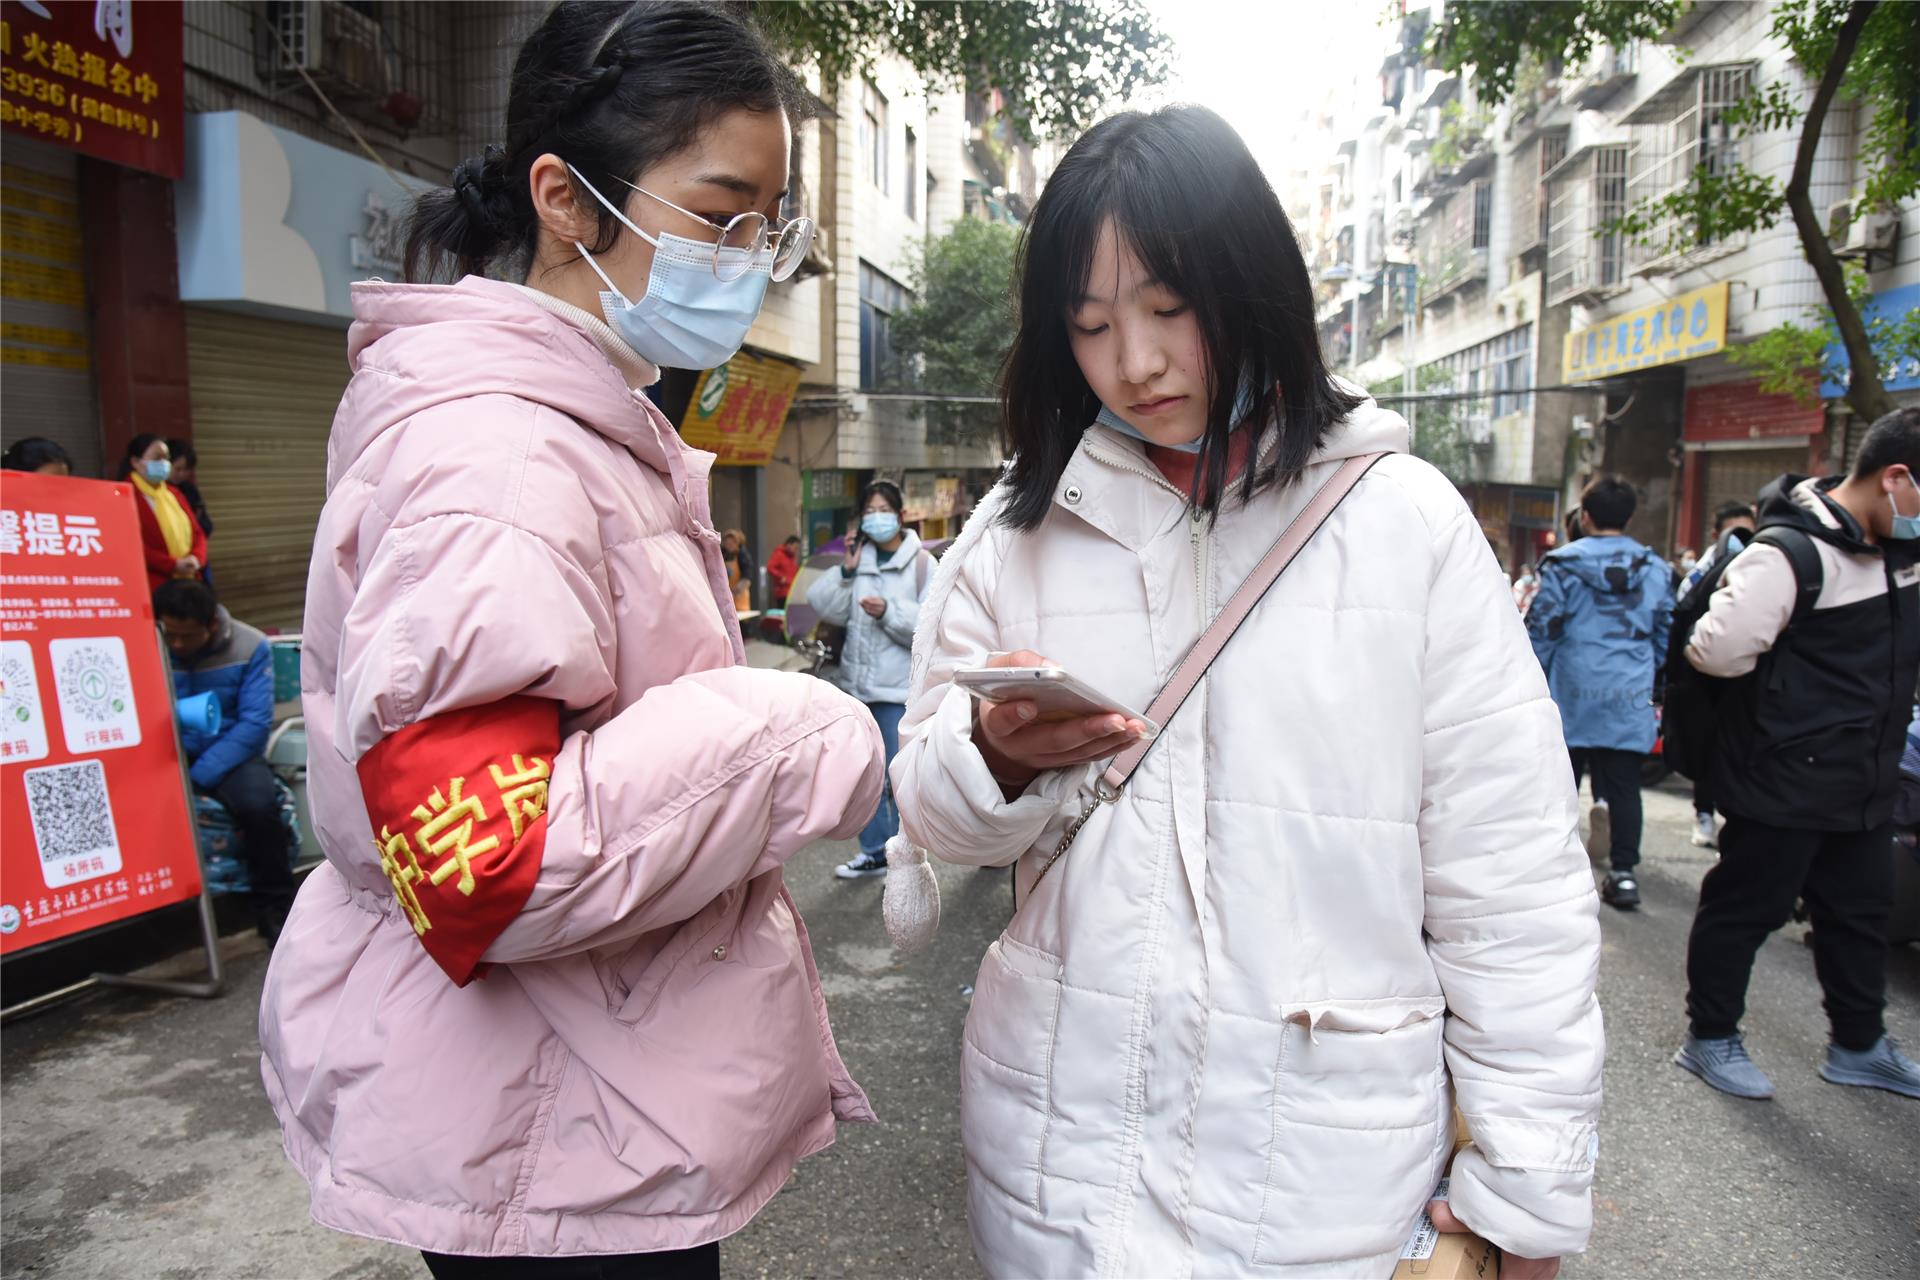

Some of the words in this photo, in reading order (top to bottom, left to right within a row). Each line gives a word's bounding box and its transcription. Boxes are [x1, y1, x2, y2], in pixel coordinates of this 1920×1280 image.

[22, 31, 159, 105] 火热报名中
[84, 728, 124, 746] 行程码
